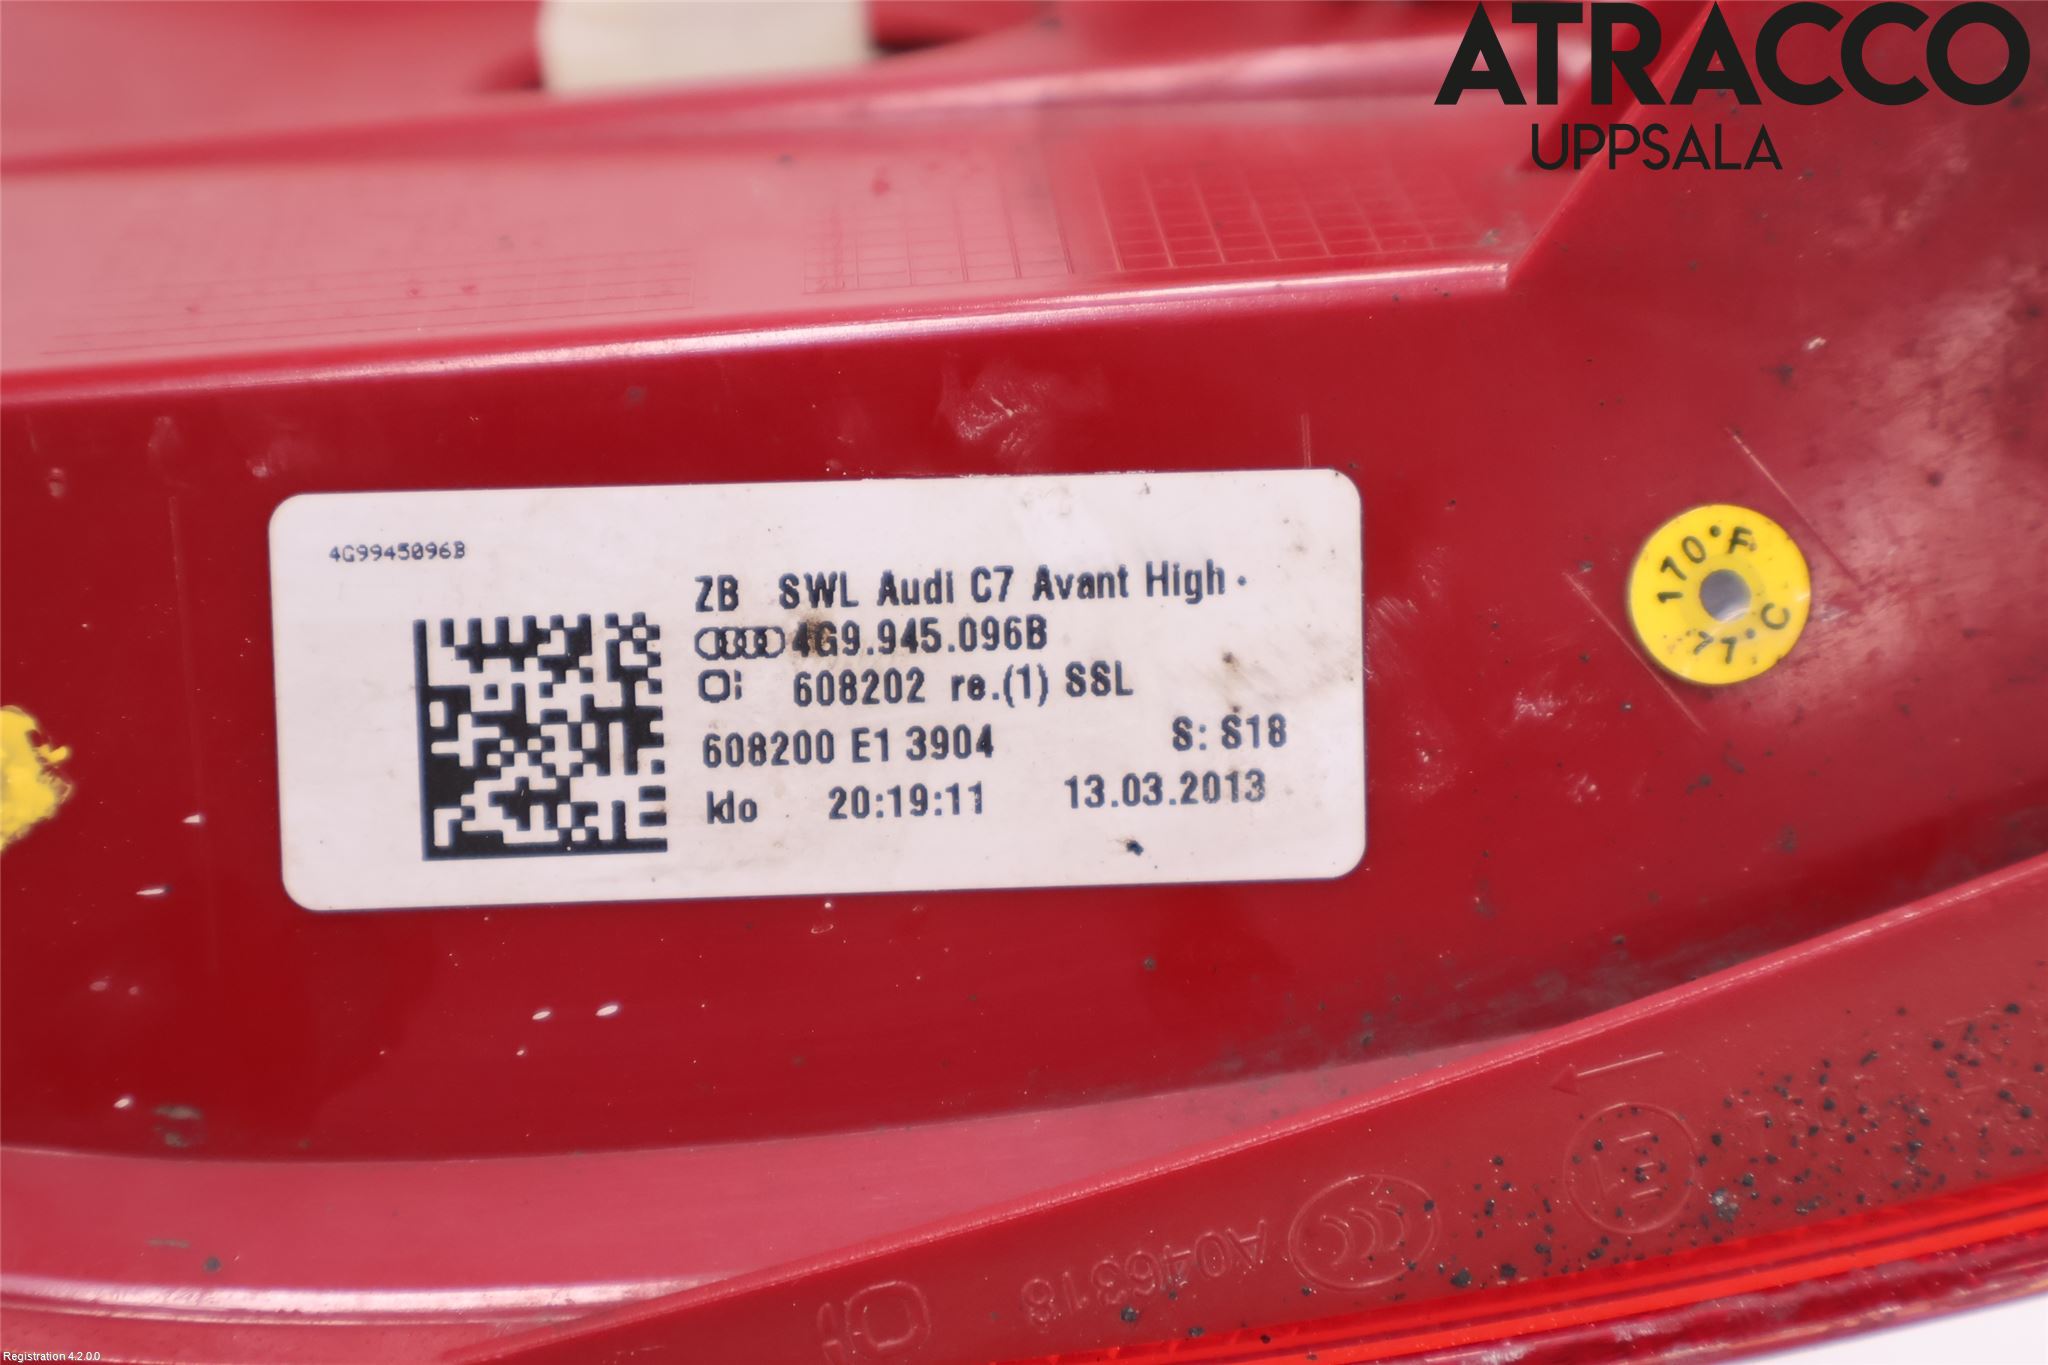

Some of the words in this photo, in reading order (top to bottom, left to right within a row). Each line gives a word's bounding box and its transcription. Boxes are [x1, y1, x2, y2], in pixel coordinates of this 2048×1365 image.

[328, 541, 466, 563] 4G9945096B
[695, 575, 740, 613] ZB
[779, 571, 859, 610] SWL
[877, 567, 954, 606] Audi
[971, 565, 1014, 603] C7
[1032, 563, 1129, 601] Avant
[1146, 559, 1226, 605] High
[791, 613, 1048, 659] 4G9.945.096B
[793, 667, 926, 708] 608202
[1065, 660, 1134, 698] SSL
[702, 729, 835, 768] 608200
[906, 723, 994, 761] 3904
[1221, 714, 1287, 749] S18
[828, 782, 983, 820] 20:19:11
[1064, 769, 1266, 809] 13.03.2013
